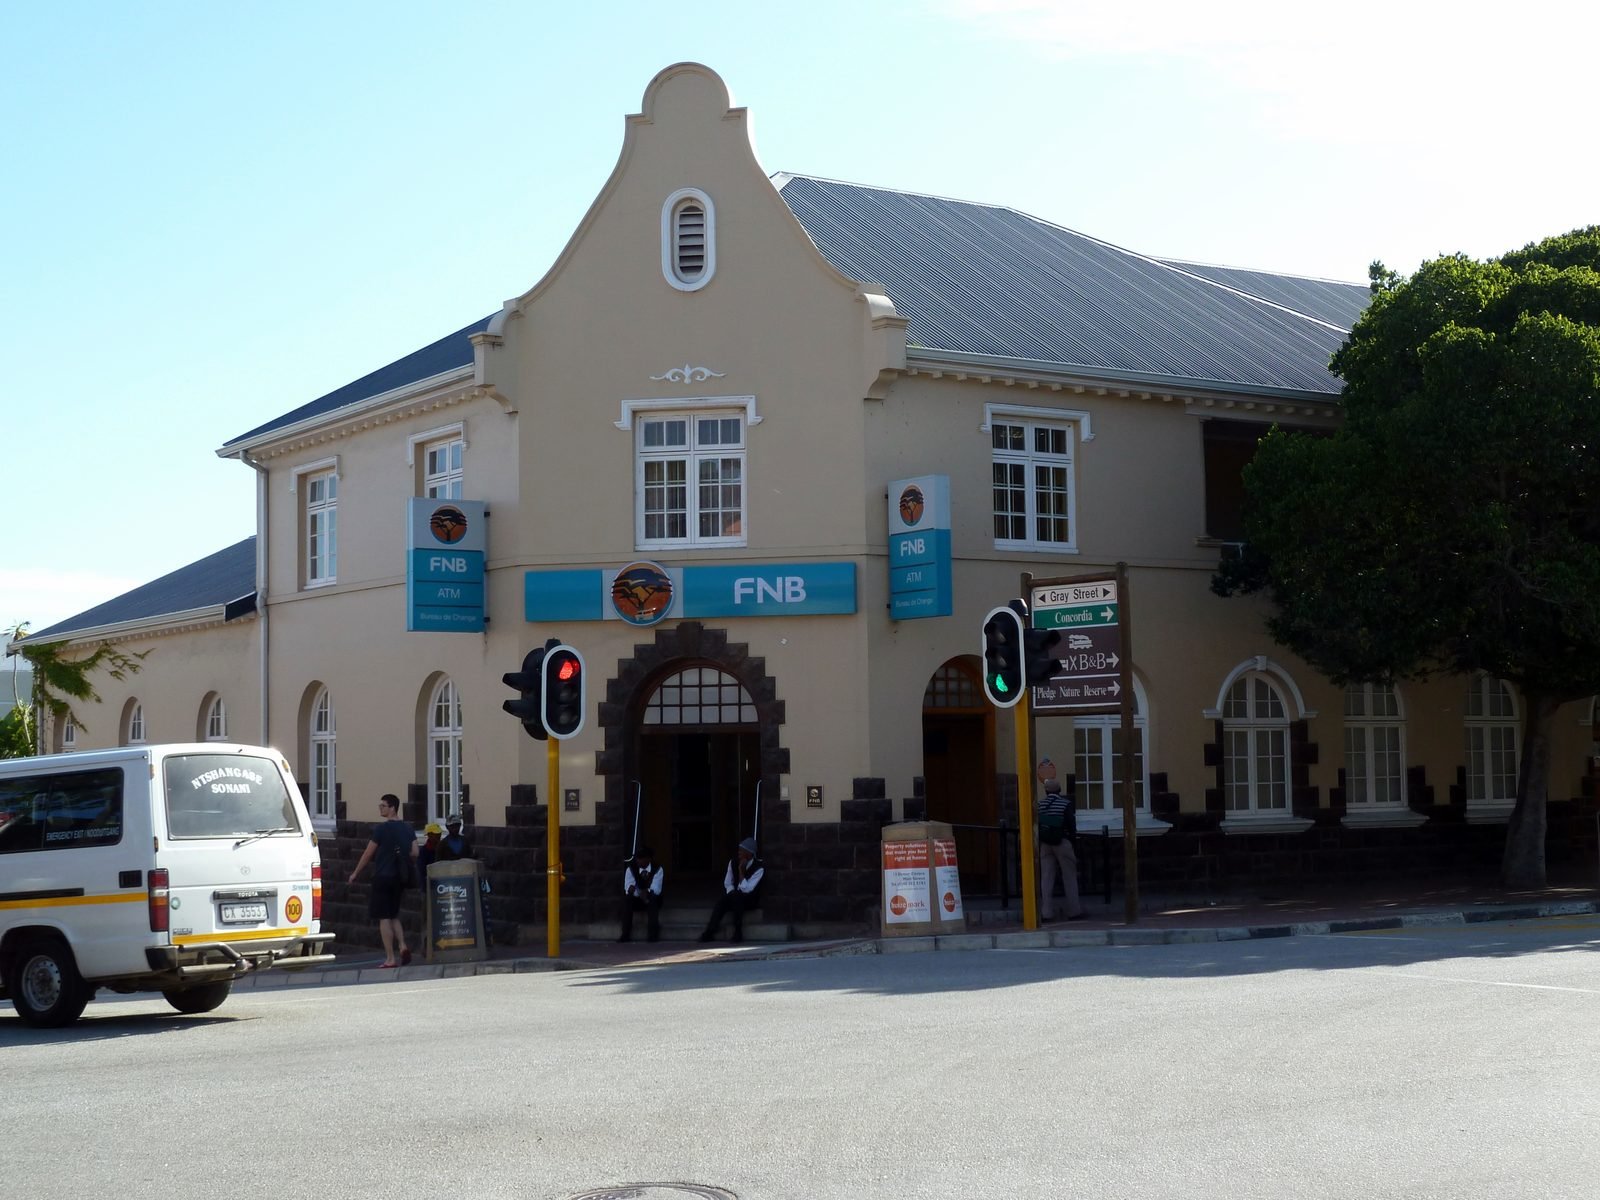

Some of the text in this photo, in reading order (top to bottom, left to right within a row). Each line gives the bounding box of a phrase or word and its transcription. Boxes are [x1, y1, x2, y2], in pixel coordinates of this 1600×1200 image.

[900, 538, 926, 557] FNB
[430, 557, 467, 573] FNB
[906, 571, 922, 583] ATM
[437, 588, 460, 598] ATM
[734, 576, 806, 604] FNB
[1050, 587, 1099, 602] Gray Street
[452, 613, 476, 622] Change
[1055, 609, 1093, 623] Concordia
[1037, 684, 1107, 700] Pledge Nature Reserve
[191, 767, 263, 789] NTSHANGABE
[211, 783, 251, 794] SONANI
[459, 888, 467, 897] 21
[224, 906, 235, 918] CX
[288, 903, 301, 915] 100
